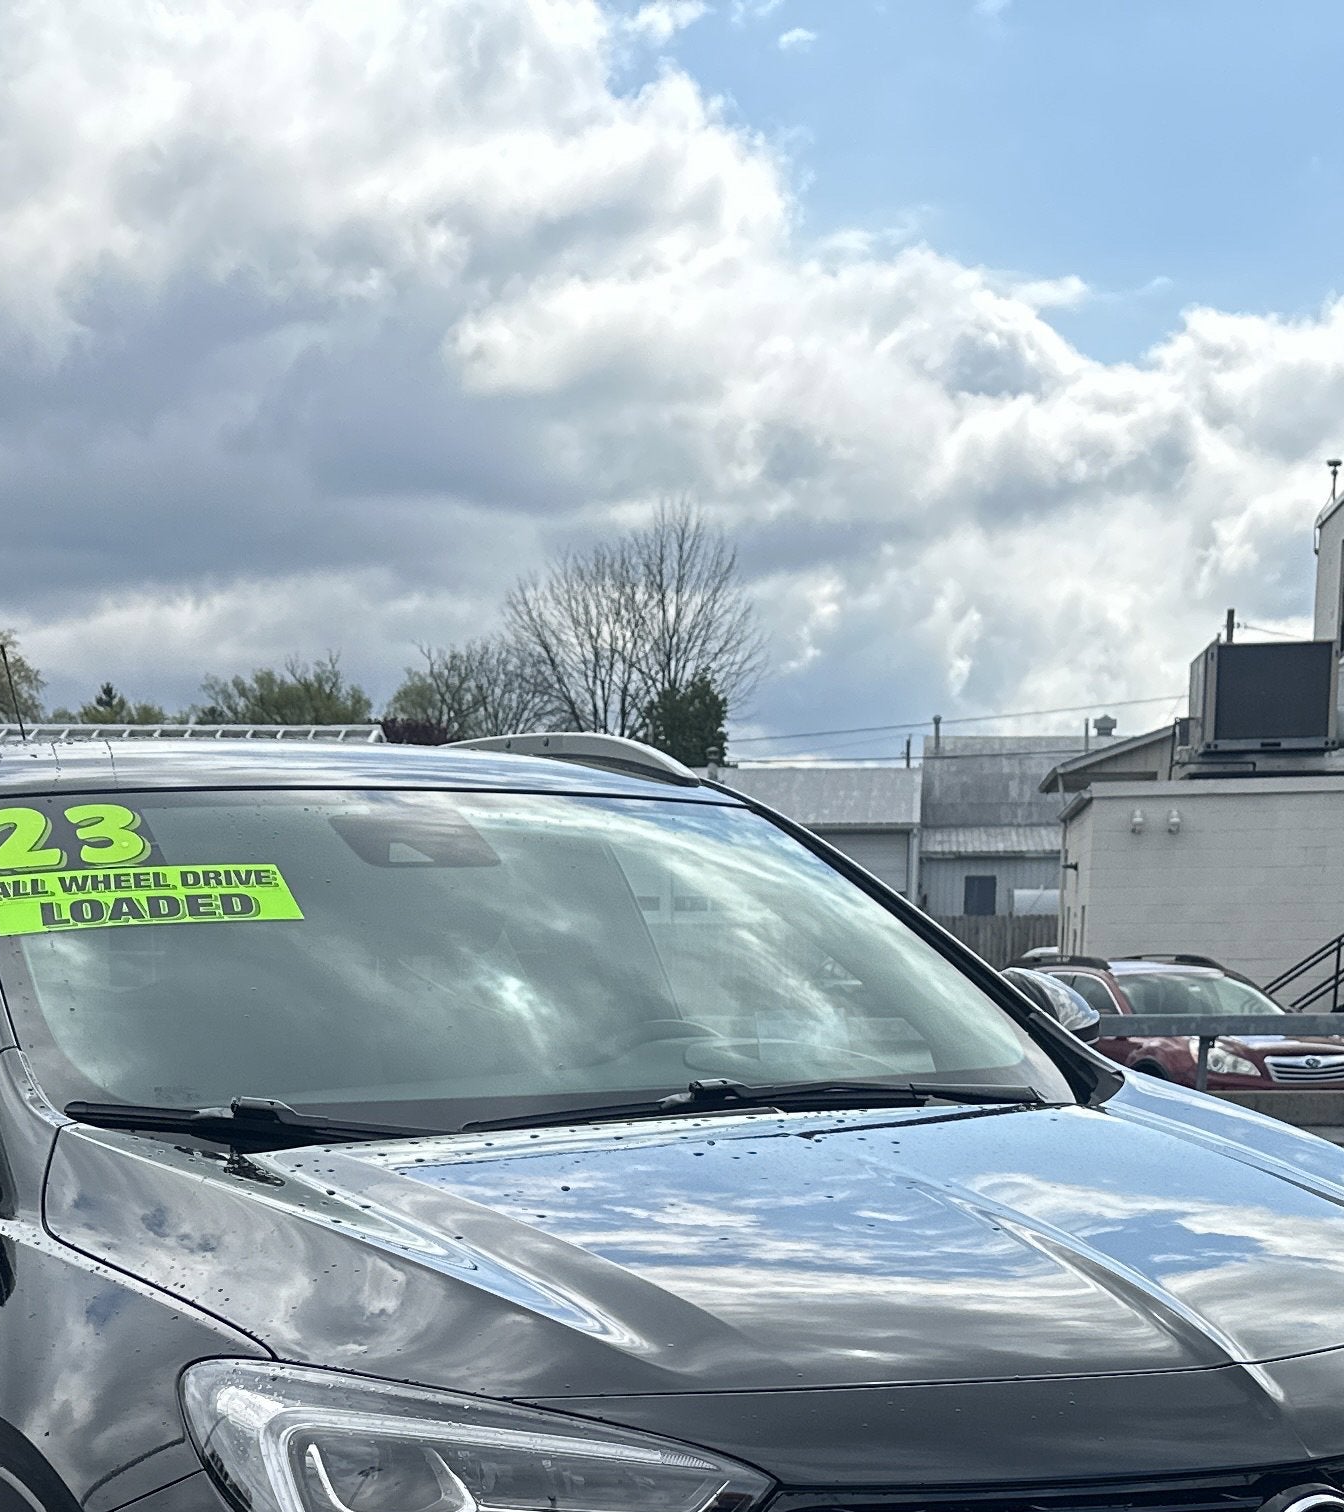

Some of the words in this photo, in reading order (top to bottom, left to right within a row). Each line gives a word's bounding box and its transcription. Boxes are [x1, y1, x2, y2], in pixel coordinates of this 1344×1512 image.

[58, 871, 176, 895] WHEEL
[180, 869, 279, 891] DRIVE
[40, 893, 261, 927] LOADED
